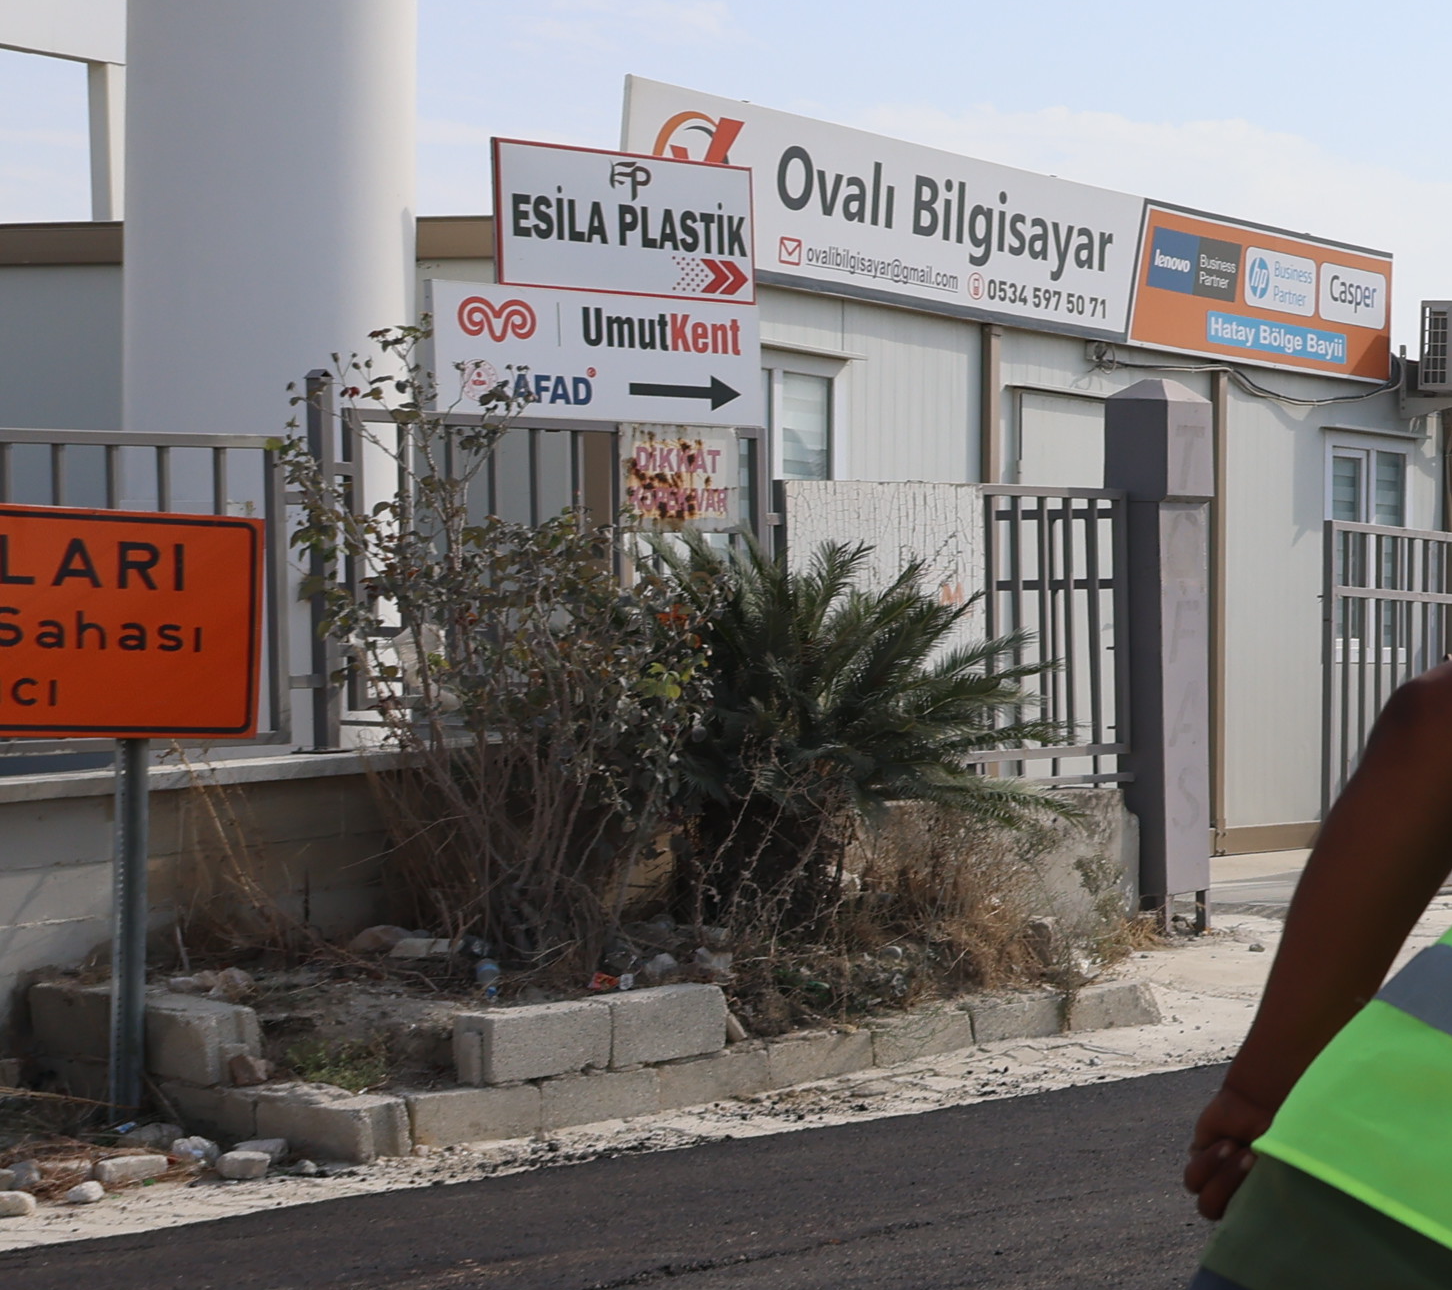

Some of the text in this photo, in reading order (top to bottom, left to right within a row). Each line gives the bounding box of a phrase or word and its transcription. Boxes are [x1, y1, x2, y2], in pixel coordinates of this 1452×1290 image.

[511, 185, 748, 258] ESİLA PLASTİK
[777, 145, 1114, 282] Ovalı Bilgisayar
[806, 246, 959, 289] ovalibilgisayar@gmail.com
[1154, 248, 1191, 273] lenovo
[1200, 254, 1237, 274] Business
[1273, 260, 1312, 284] Business
[1199, 271, 1229, 289] Partner
[1273, 285, 1307, 307] Partner
[1329, 275, 1377, 314] Casper
[987, 279, 1107, 319] 0534 597 50 71
[582, 307, 741, 355] UmutKent
[1210, 316, 1343, 360] Hatay Bölge Bayii
[512, 373, 593, 406] AFAD
[635, 446, 722, 474] DİKKAT
[695, 488, 729, 513] VAR
